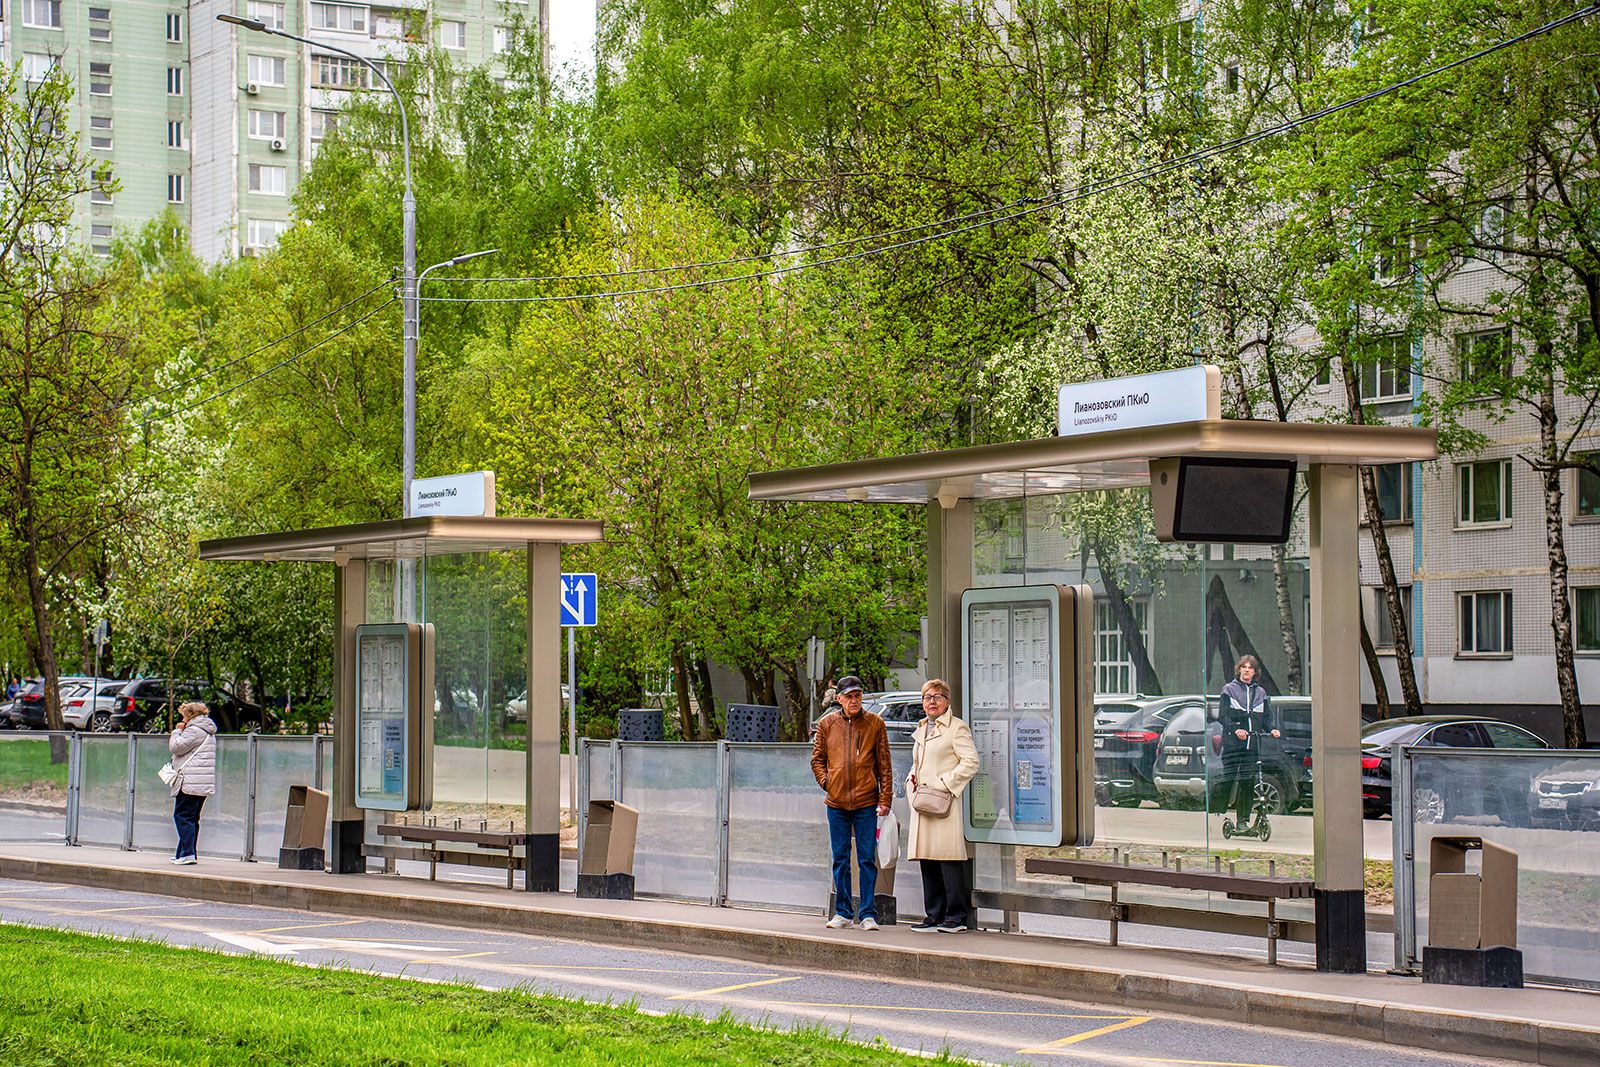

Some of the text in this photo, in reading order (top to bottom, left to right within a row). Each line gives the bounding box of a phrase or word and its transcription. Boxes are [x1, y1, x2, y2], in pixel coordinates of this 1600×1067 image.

[1074, 392, 1149, 413] Лианозовский ПКиО
[1074, 413, 1117, 426] Lianozovskiy PKiO
